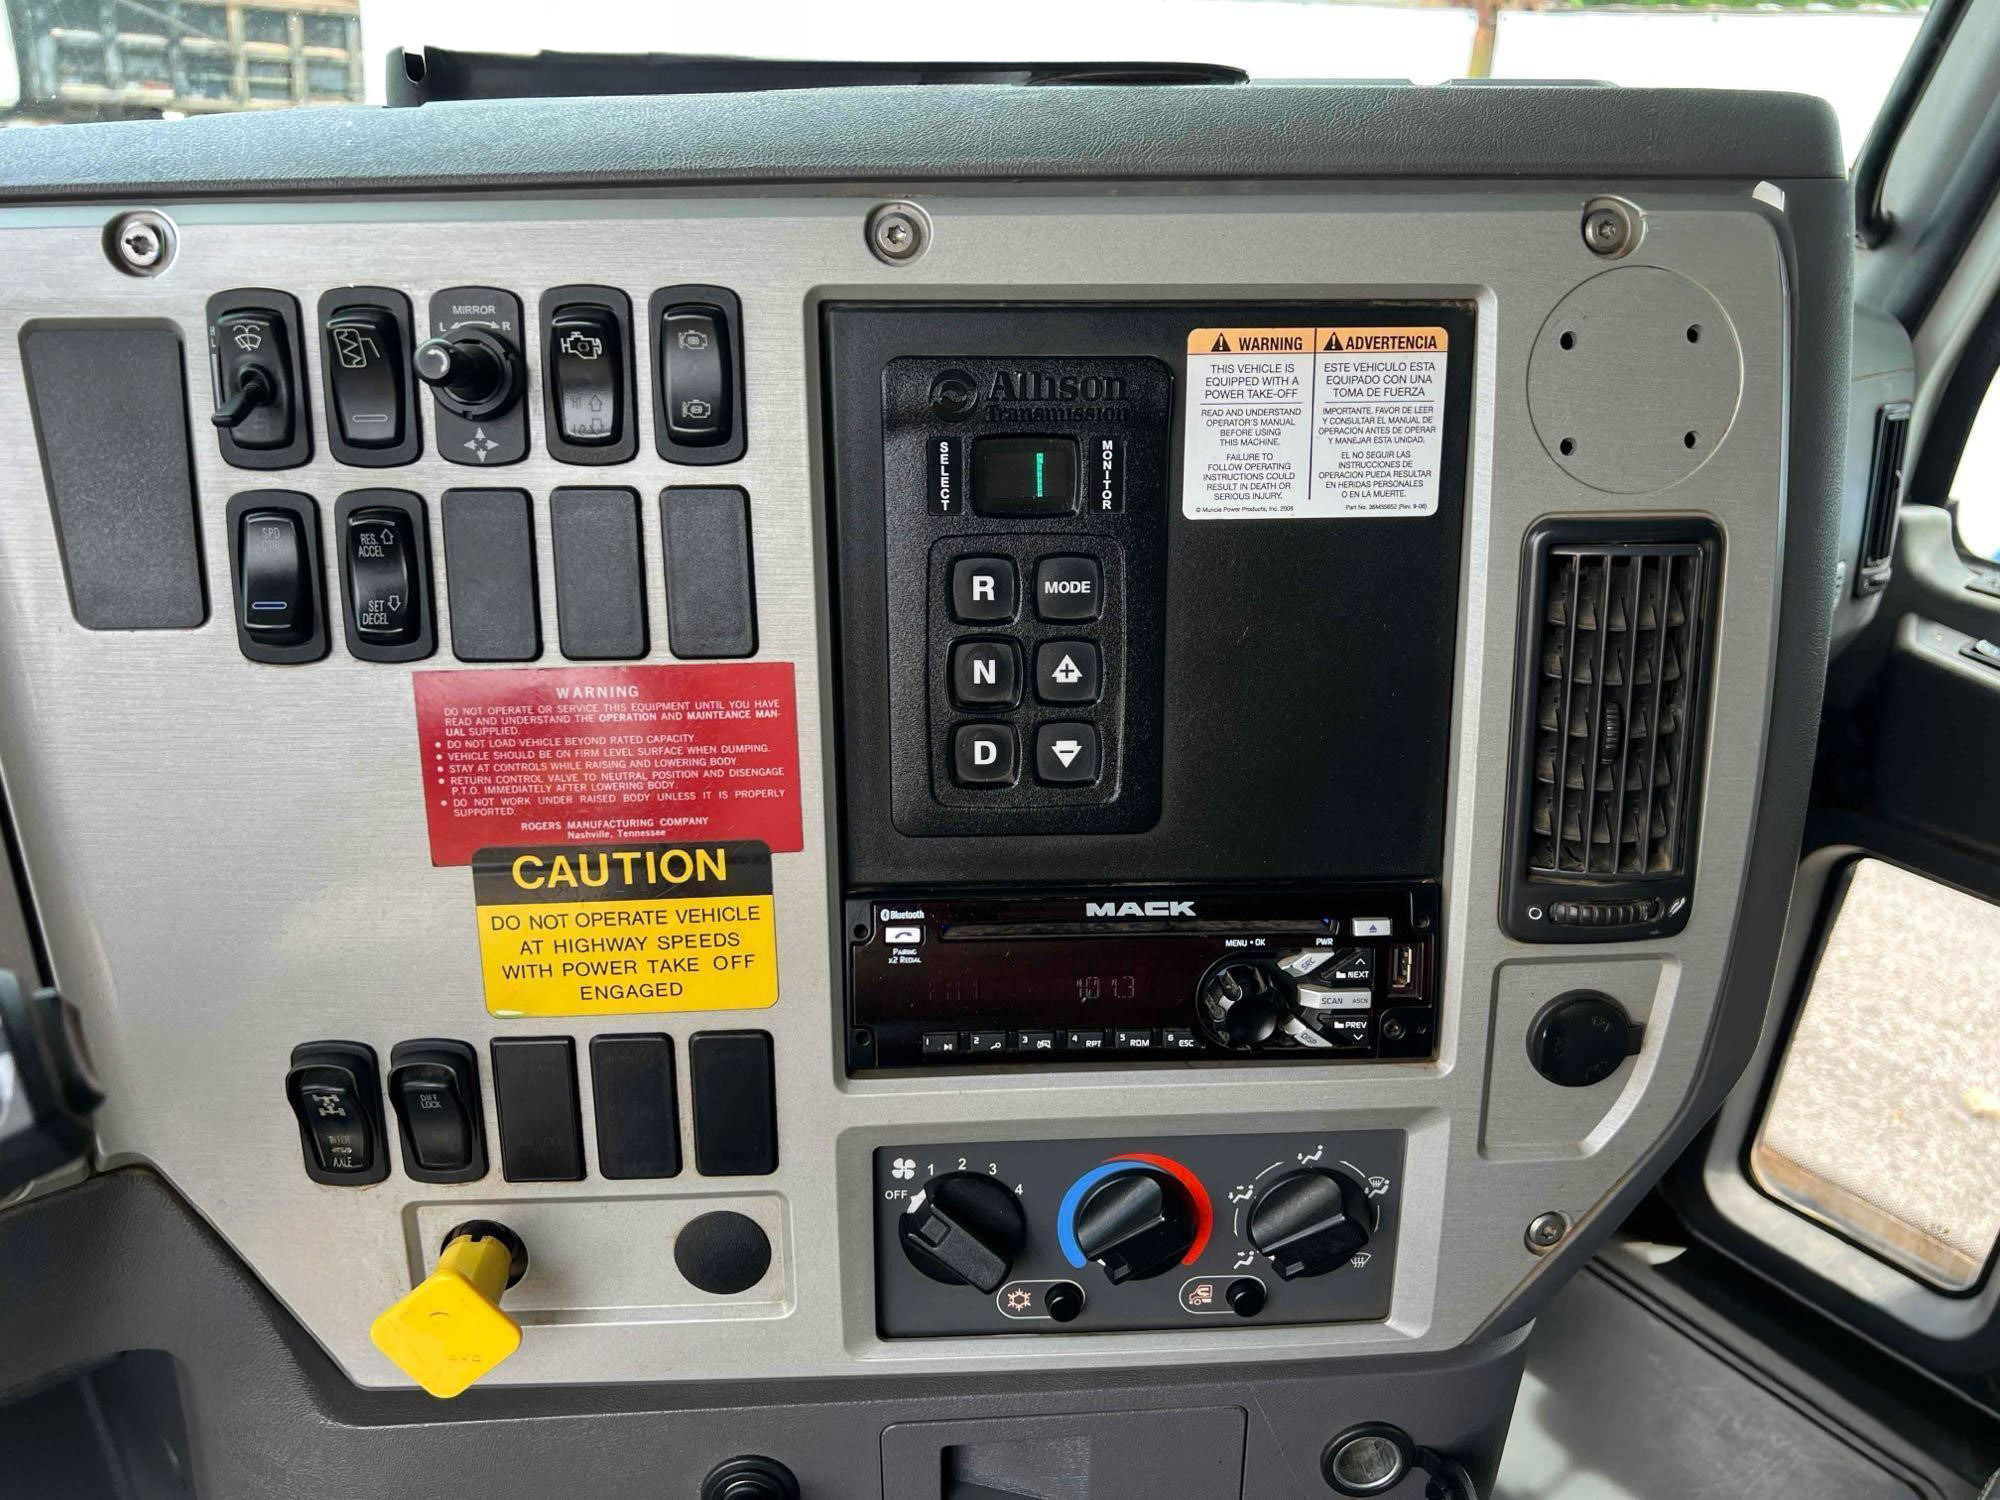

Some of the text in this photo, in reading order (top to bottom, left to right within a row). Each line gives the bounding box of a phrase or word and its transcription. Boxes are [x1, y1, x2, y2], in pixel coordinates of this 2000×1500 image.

[452, 306, 496, 315] MIRROR
[439, 323, 446, 332] L
[503, 322, 511, 331] R
[1238, 337, 1303, 351] WARNING
[1345, 336, 1437, 350] ADVERTENCIA
[1211, 364, 1295, 374] THIS VEHICLE IS
[1324, 362, 1350, 372] ESTE
[1206, 377, 1299, 387] EQUIPPED WITH A
[1326, 375, 1433, 385] EQUIPADO CON UNA
[1205, 389, 1298, 399] POWER TAKE-OFF
[1333, 387, 1425, 397] TOMA DE FUERZA
[1201, 409, 1223, 417] READ
[1246, 408, 1301, 416] UNDERSTAND
[1220, 428, 1281, 437] BEFORE USING
[1226, 453, 1260, 461] FAILURE
[1208, 462, 1291, 471] FOLLOW OPERATING
[1338, 460, 1413, 469] INSTRUCCIONES DE
[939, 441, 949, 511] SELECT
[1036, 452, 1044, 497] 1
[1102, 440, 1113, 510] MONITOR
[1203, 472, 1295, 481] INSTRUCTIONS COULD
[1366, 470, 1392, 478] PUEDA
[1393, 470, 1432, 478] RESULTAR
[1207, 483, 1237, 491] RESULT
[1250, 482, 1276, 490] DEATH
[1278, 482, 1291, 490] OR
[1373, 480, 1424, 488] PERSONALES
[262, 528, 280, 540] SPD
[360, 534, 378, 545] RES.
[358, 546, 384, 558] ACCEL
[972, 576, 995, 601] R
[1044, 581, 1091, 594] MODE
[368, 600, 384, 612] SET
[362, 613, 389, 625] DECEL
[973, 659, 996, 684] N
[556, 685, 639, 699] WARNING
[444, 699, 780, 717] DO NOT OPERATE OR SERVICE THIS EQUIPMENT UNTIL YOU HAVE
[445, 709, 781, 726] READ AND UNDERSTAND THE OPERATION AND MAINTEANCE MAN-
[446, 727, 520, 737] UAL SUPPLIED.
[447, 734, 697, 749] DO NOT LOAD VEHICLE BEYOND RATED CAPACITY.
[448, 744, 771, 761] VEHICLE SHOULD BE ON FIRM LEVEL SURFACE WHEN DUMPING.
[974, 740, 997, 765] D
[521, 817, 709, 831] ROGERS MANUFACTURING COMPANY
[617, 829, 666, 838] Tennessee
[511, 848, 727, 890] CAUTION
[890, 910, 925, 920] Bluetooth
[1086, 901, 1197, 917] MACK
[491, 906, 760, 931] DO NOT OPERATE VEHICLE
[520, 932, 740, 955] AT HIGHWAY SPEEDS
[1225, 939, 1247, 947] MENU
[1316, 938, 1333, 946] PWR
[502, 954, 756, 980] WITH POWER TAKE OFF
[1301, 957, 1317, 971] SRC
[1348, 970, 1369, 979] NEXT
[580, 982, 683, 1000] ENGAGED
[1321, 997, 1343, 1005] SCAN
[1345, 1021, 1367, 1029] PREV
[1022, 1036, 1028, 1044] 3
[1072, 1035, 1101, 1048] 4 RPT
[1168, 1034, 1194, 1047] 6 ESC
[421, 1101, 442, 1109] LOCK
[333, 1156, 352, 1168] AXLE
[958, 1158, 967, 1170] 2
[928, 1164, 934, 1176] 1
[989, 1164, 997, 1175] 3
[885, 1190, 908, 1200] OFF
[1014, 1183, 1024, 1196] 4
